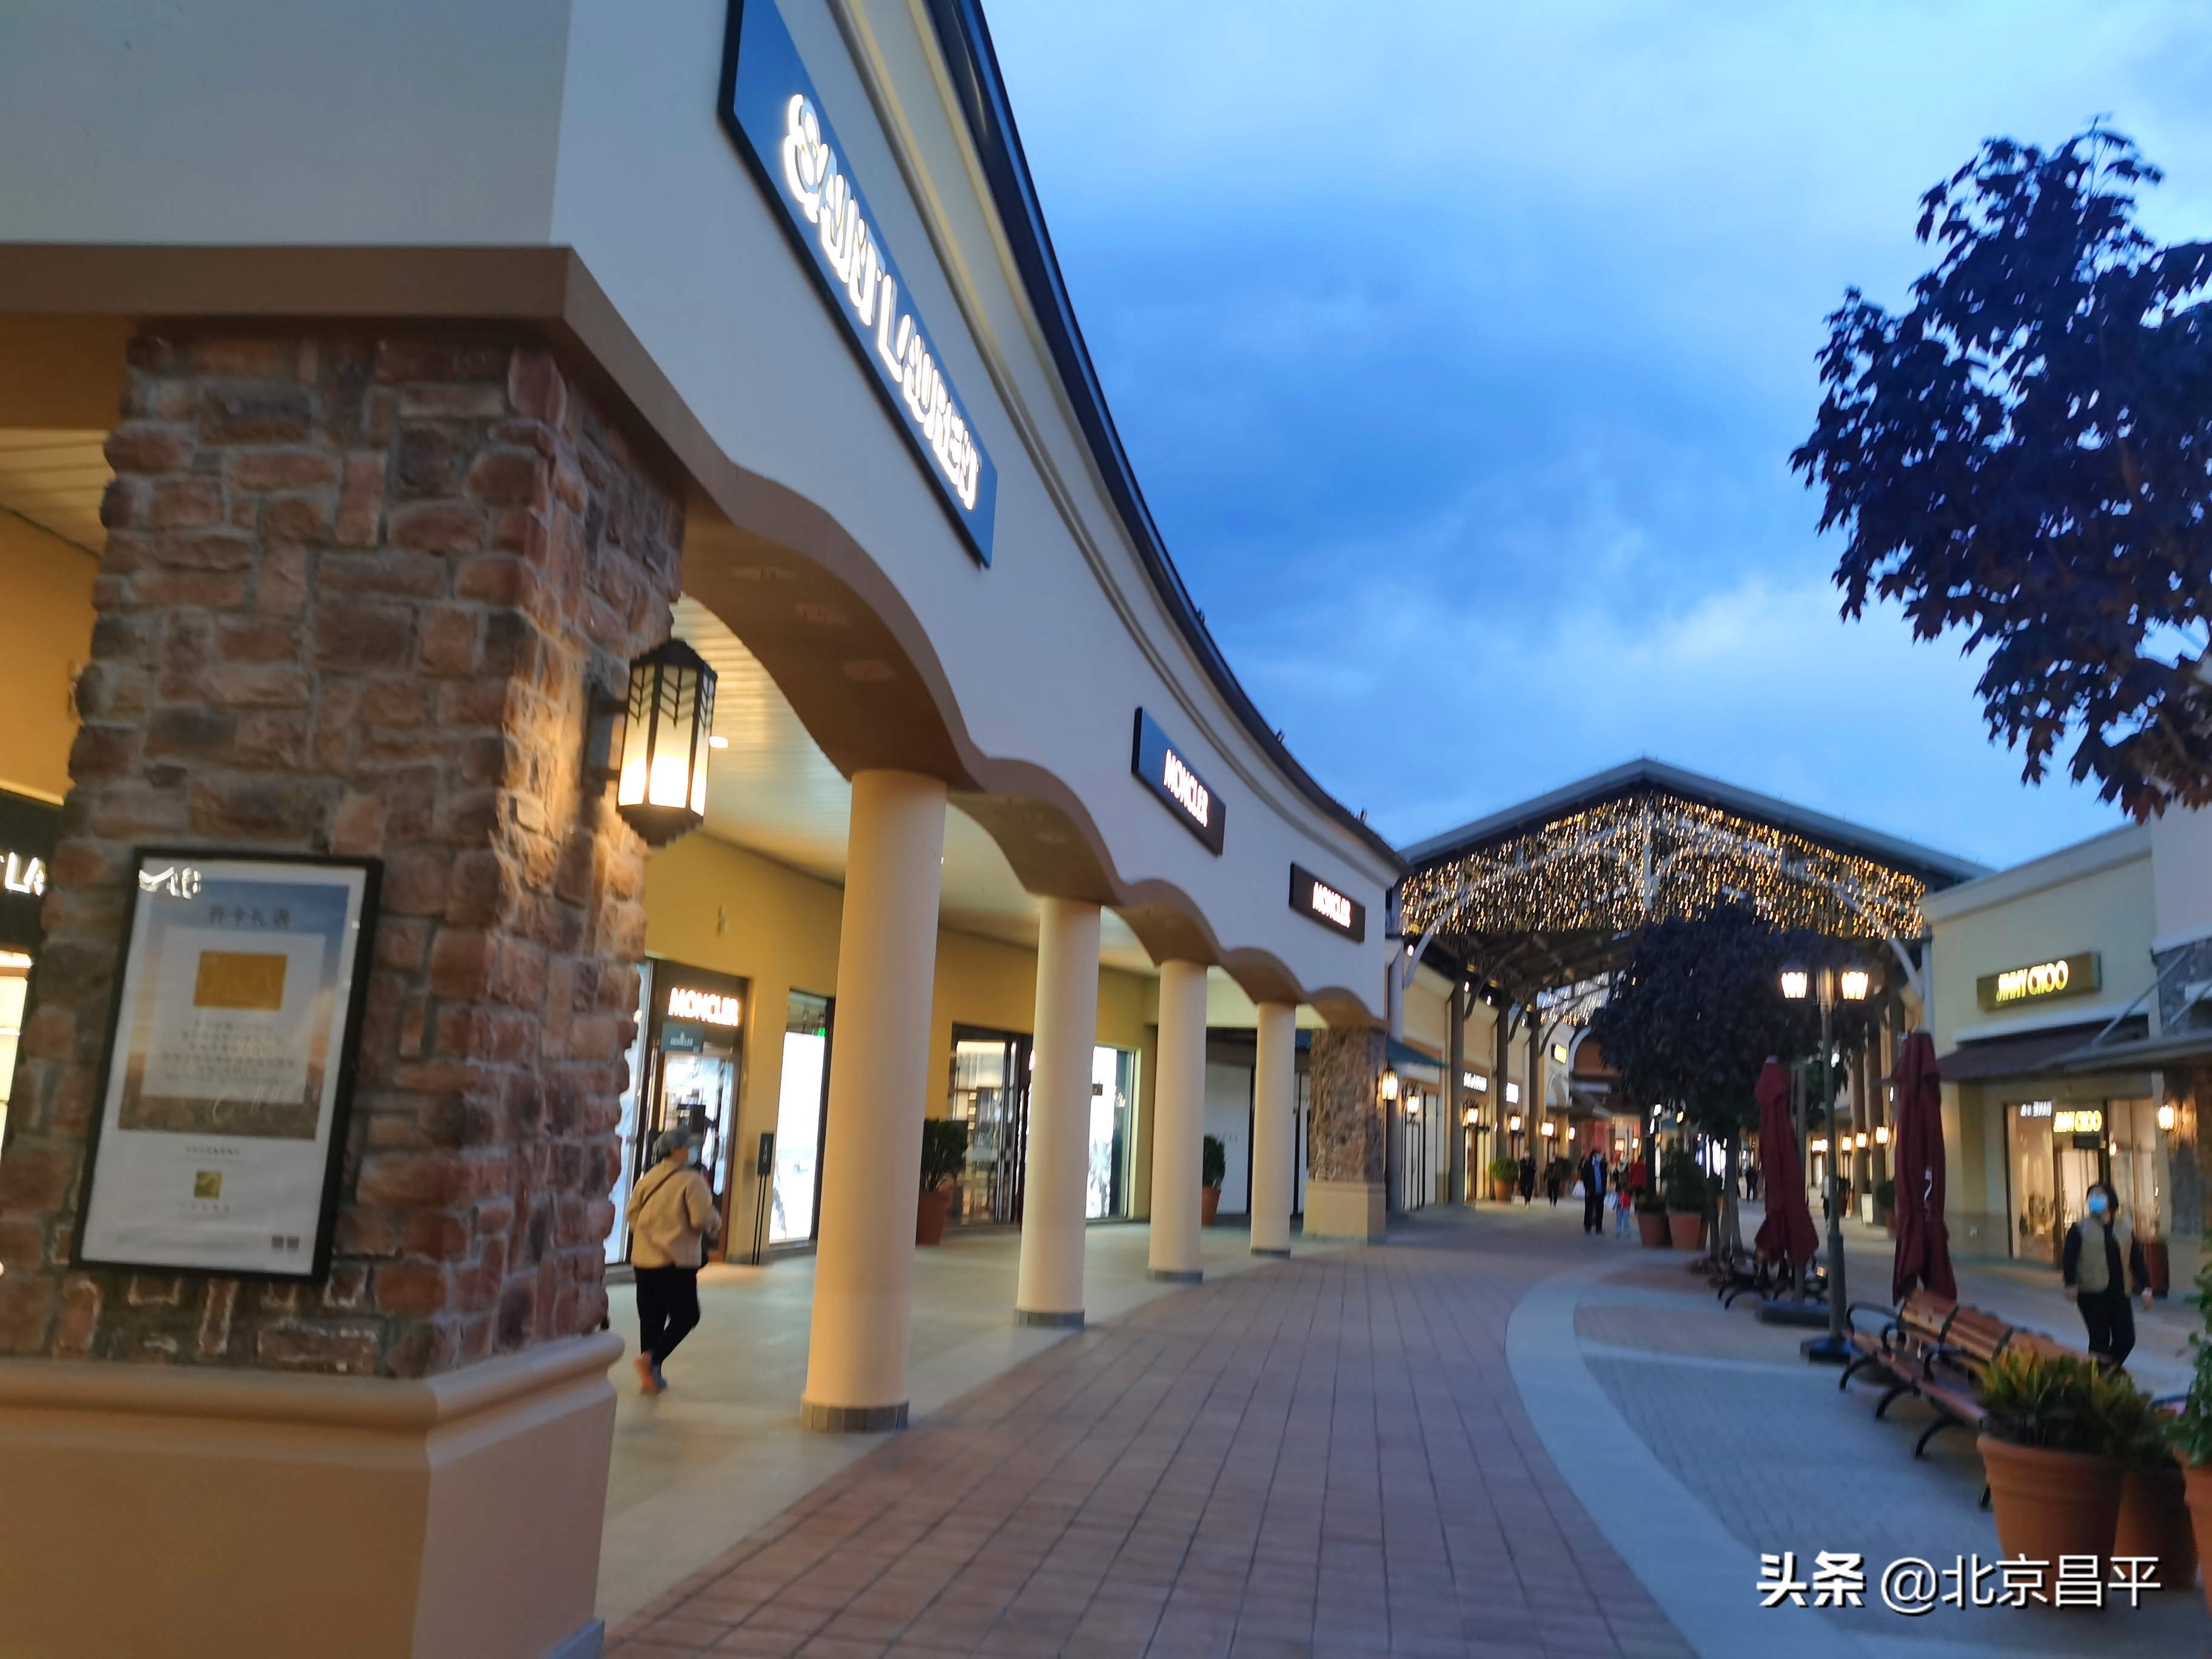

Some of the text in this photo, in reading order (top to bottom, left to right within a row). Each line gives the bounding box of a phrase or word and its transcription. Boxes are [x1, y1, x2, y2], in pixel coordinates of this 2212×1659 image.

[783, 93, 980, 510] SAINT LAURENT
[1163, 748, 1210, 828] MONCLER
[1312, 882, 1352, 928] MONCLER
[1995, 959, 2070, 1004] JIMMY CHOO
[668, 987, 739, 1027] MONCLER
